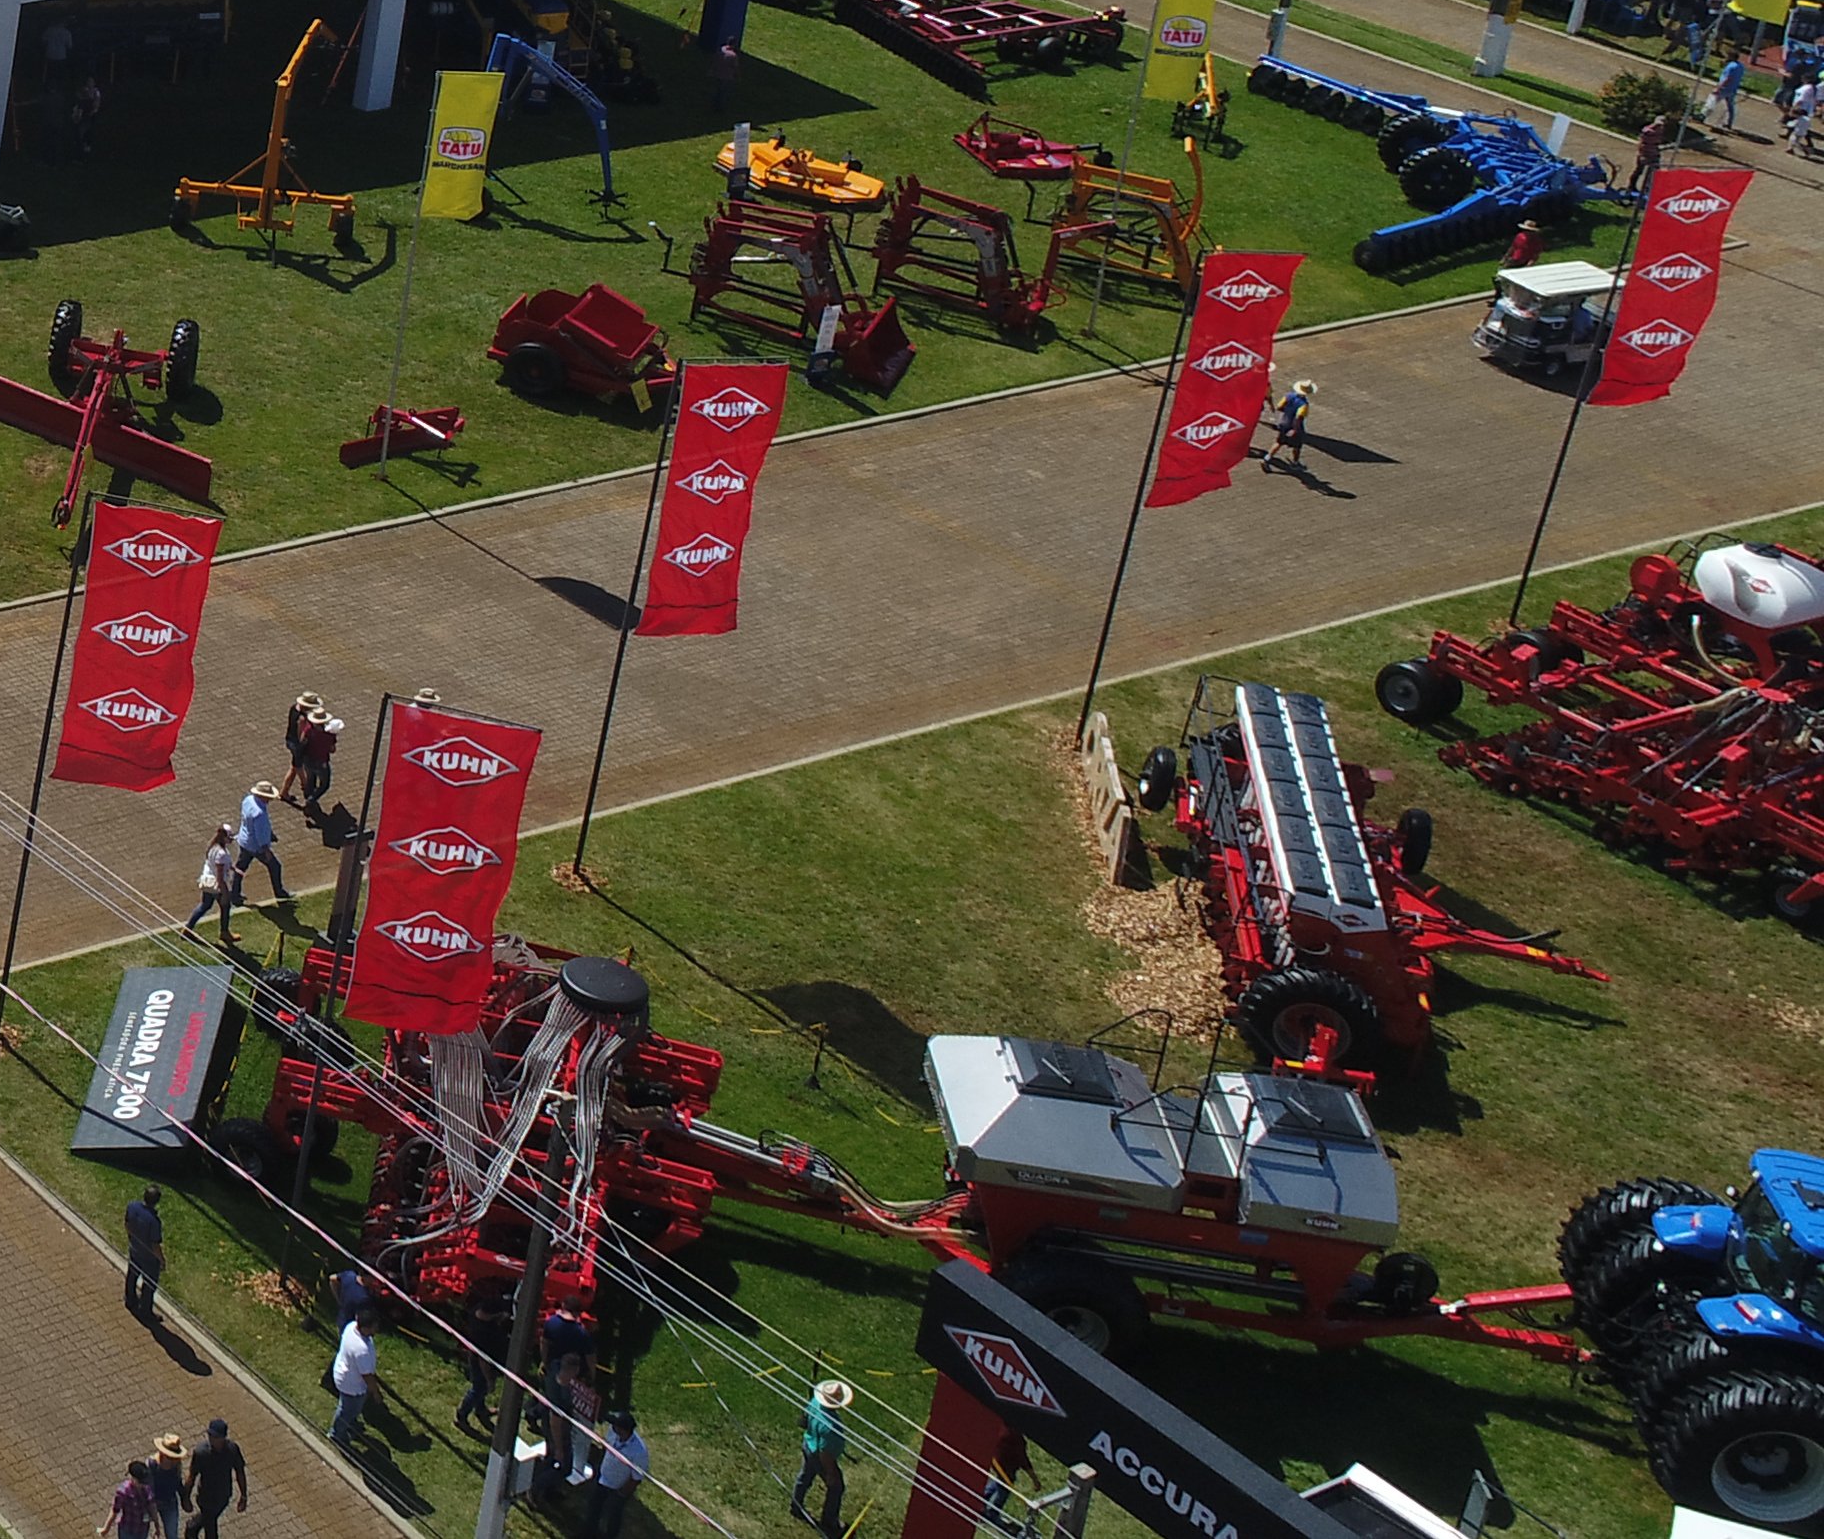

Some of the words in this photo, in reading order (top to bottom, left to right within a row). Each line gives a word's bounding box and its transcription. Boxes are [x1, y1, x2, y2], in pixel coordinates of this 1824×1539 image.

[1163, 30, 1203, 44] TATU
[440, 141, 481, 156] TATU
[1666, 198, 1720, 215] KUHN
[1648, 265, 1701, 280] KUHN
[1218, 284, 1271, 300] KUHN
[1631, 332, 1682, 346] KUHN
[1201, 354, 1254, 370] KUHN
[702, 401, 759, 418] KUHN
[1184, 420, 1231, 443] KUHN
[692, 474, 745, 492] KUHN
[122, 541, 188, 563] KUHN
[675, 546, 729, 565] KUHN
[109, 623, 173, 645] KUHN
[96, 700, 163, 723] KUHN
[422, 750, 499, 777] KUHN
[409, 839, 484, 866] KUHN
[394, 924, 470, 951] KUHN
[128, 987, 175, 1068] QUADRA
[111, 1065, 155, 1120] 7500
[1017, 1169, 1070, 1185] QUADRA
[963, 1335, 1046, 1407] KUHN
